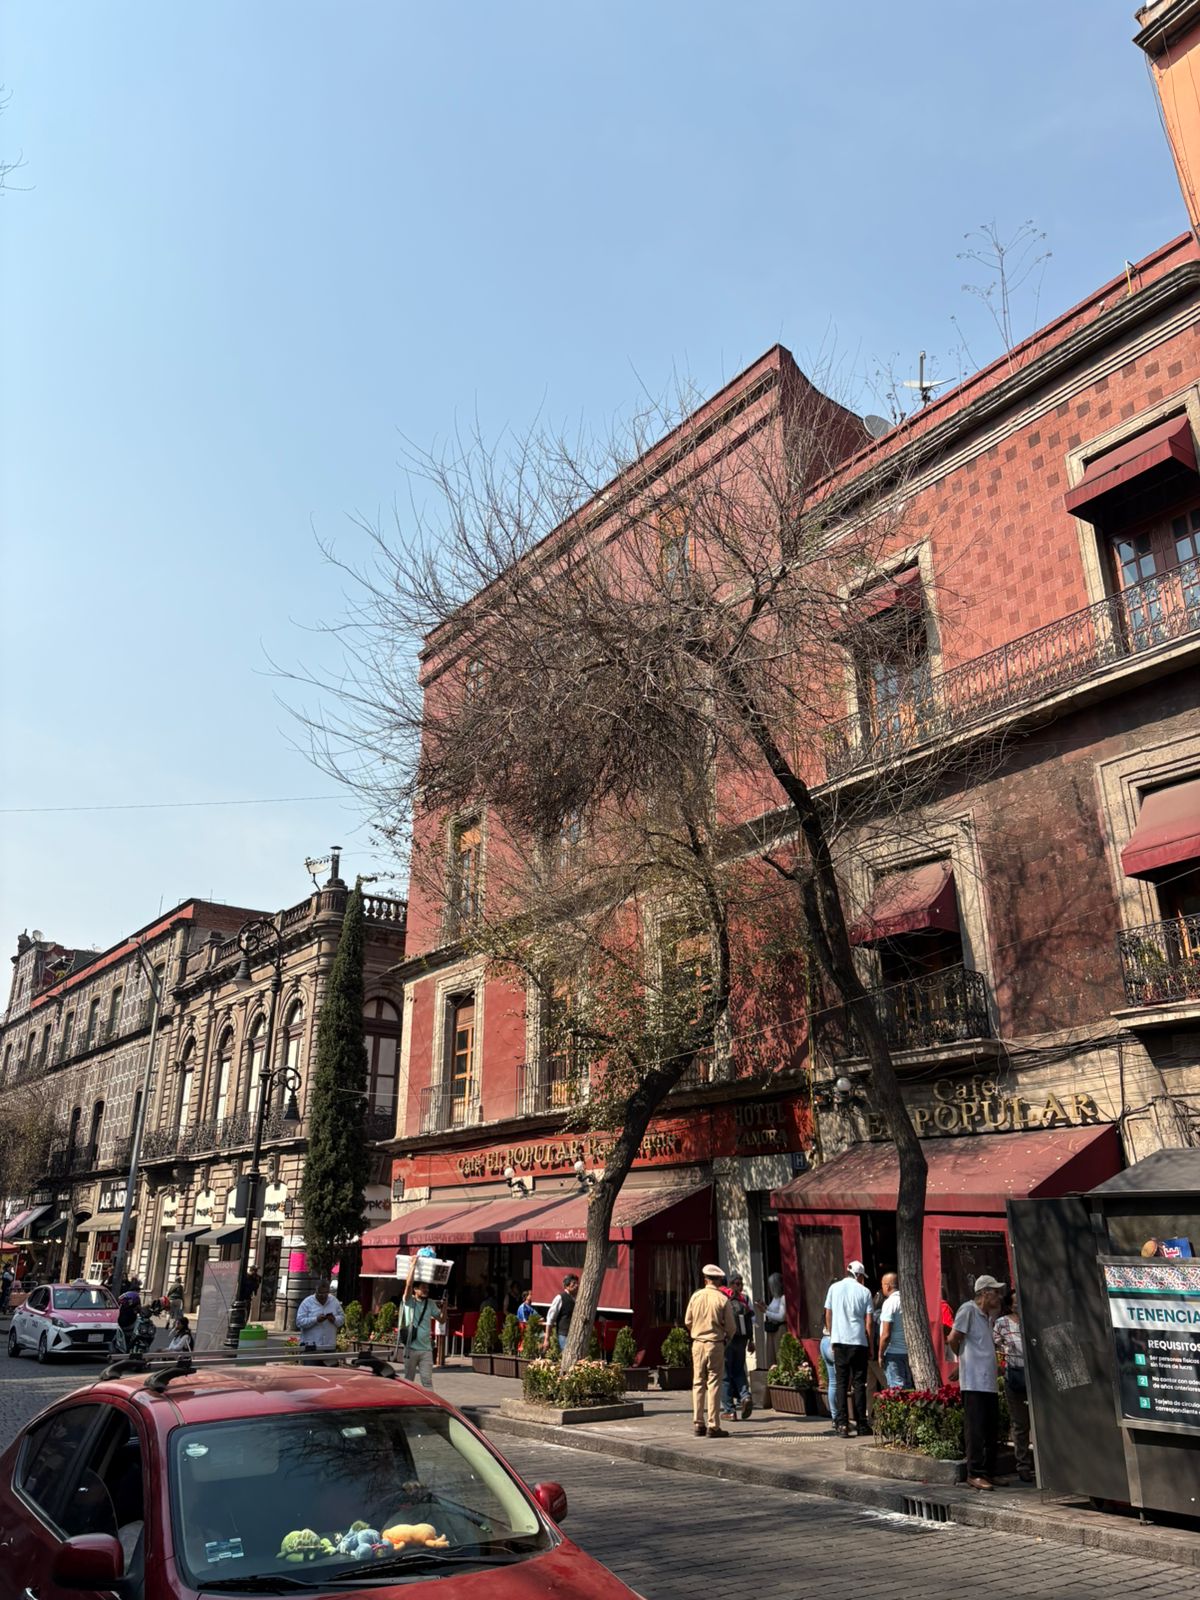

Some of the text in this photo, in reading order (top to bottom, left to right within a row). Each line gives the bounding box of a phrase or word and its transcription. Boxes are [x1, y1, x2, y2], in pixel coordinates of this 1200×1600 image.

[932, 1073, 1002, 1101] Café
[735, 1102, 786, 1126] HOTEL
[865, 1092, 1096, 1137] E POPULAR
[485, 1151, 504, 1171] EL
[506, 1139, 579, 1167] POPULAR
[1126, 1307, 1200, 1324] TENENCIA
